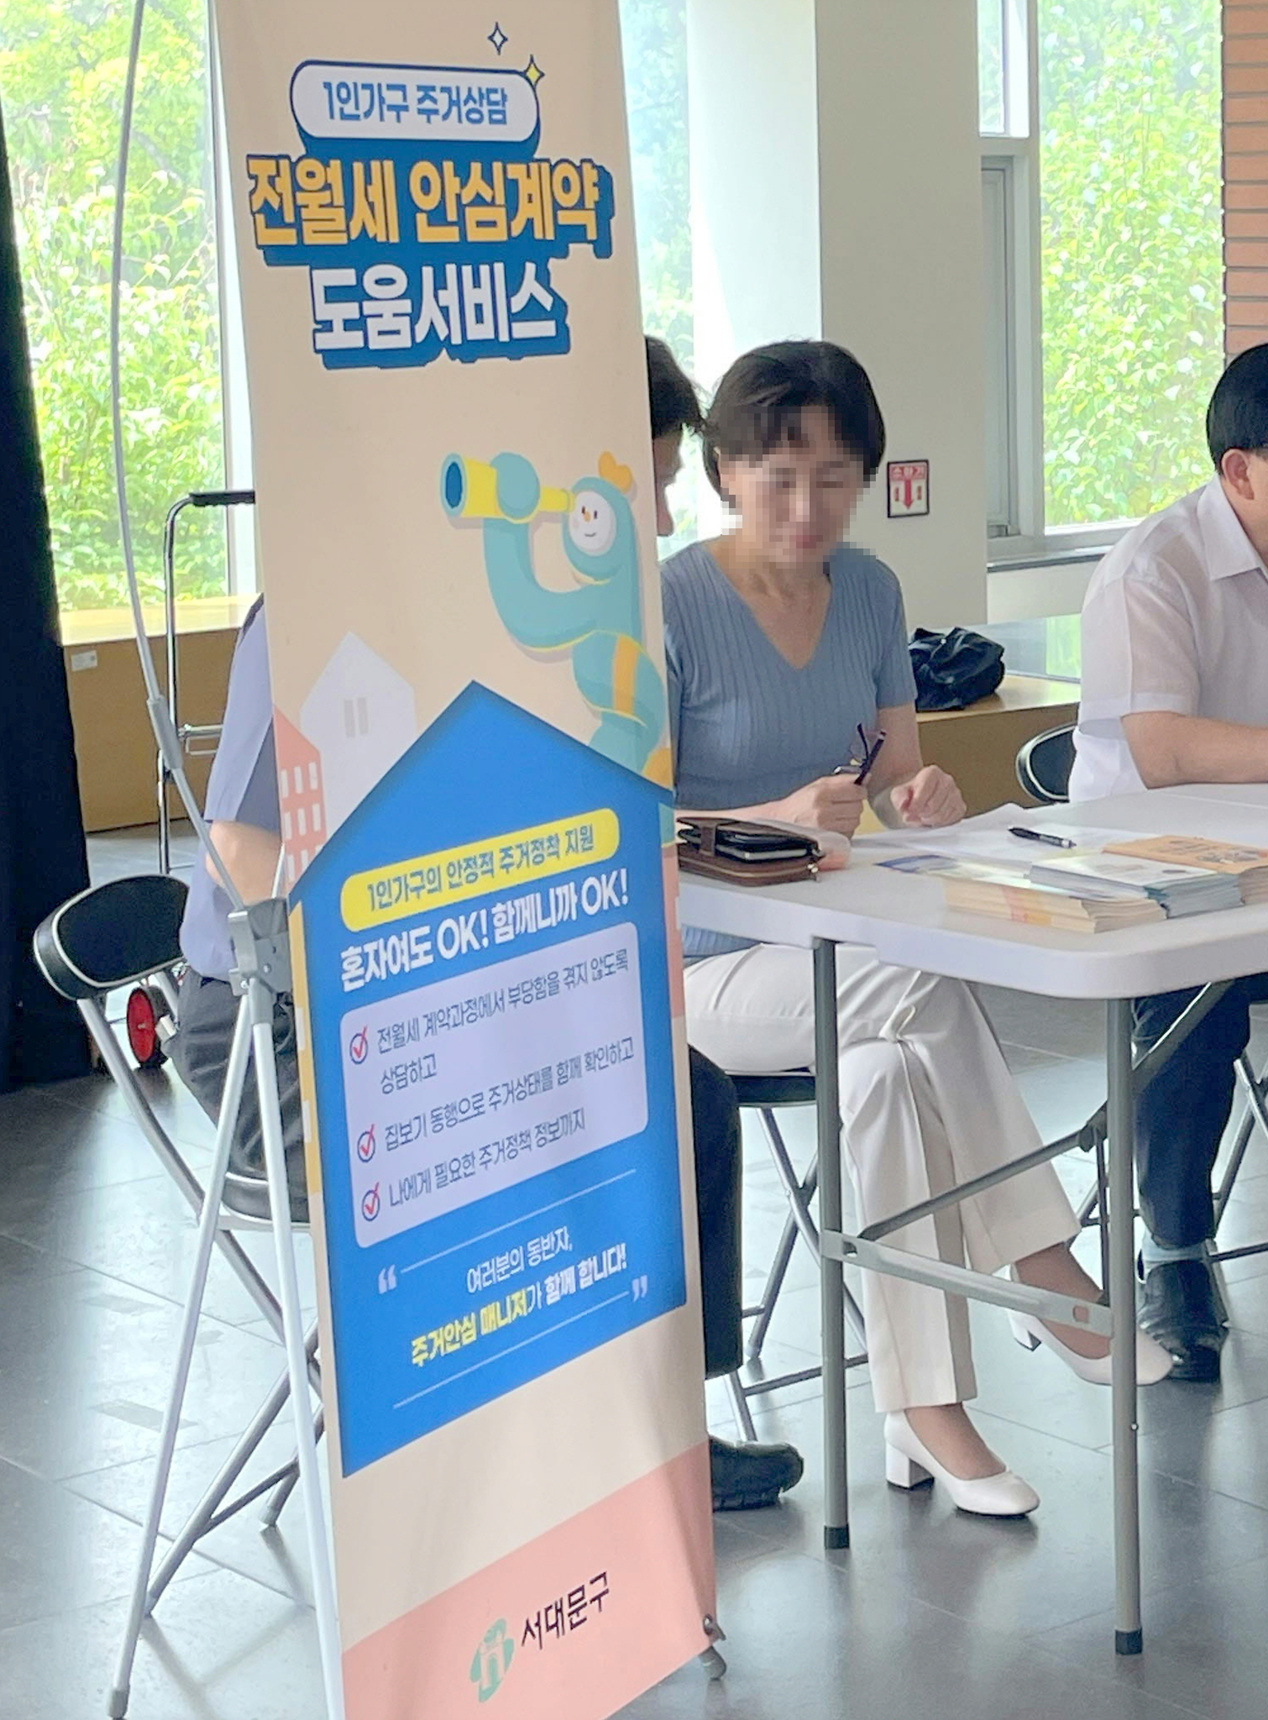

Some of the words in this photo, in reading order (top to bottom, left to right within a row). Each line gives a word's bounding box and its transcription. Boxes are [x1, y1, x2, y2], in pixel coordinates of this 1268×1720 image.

[323, 81, 410, 122] 1인가구
[416, 84, 508, 125] 주거상담
[248, 157, 400, 246] 전월세
[409, 159, 600, 243] 안심계약
[313, 262, 557, 350] 도움서비스
[367, 866, 443, 911] 1인가구의
[446, 851, 495, 888] 안정적
[499, 833, 560, 874] 주거정착
[565, 824, 594, 855] 지원
[341, 925, 434, 992] 혼자여도
[437, 908, 489, 960] OK!
[491, 882, 578, 945] 함께니까
[582, 868, 628, 915] OK!
[377, 1017, 420, 1054] 전월세
[423, 988, 505, 1037] 계약과정에서
[507, 970, 560, 1008] 부당함을
[563, 961, 588, 990] 겪지
[590, 948, 629, 981] 않도록
[380, 1053, 437, 1095] 상담하고
[385, 1113, 428, 1151] 집보기
[430, 1092, 486, 1134] 동행으로
[488, 1065, 553, 1111] 주거상태를
[556, 1055, 582, 1086] 함께
[584, 1036, 634, 1071] 확인하고
[389, 1168, 432, 1207] 나에게
[434, 1153, 476, 1190] 필요한
[478, 1129, 532, 1170] 주거정책
[534, 1107, 585, 1148] 정보까지
[467, 1246, 525, 1294] 여러분의
[527, 1226, 573, 1267] 동반자,
[412, 1312, 477, 1367] 주거안심
[480, 1281, 542, 1335] 매니저가
[544, 1266, 576, 1305] 함께
[577, 1243, 627, 1290] 합니다!
[521, 1570, 610, 1650] 서대문구
